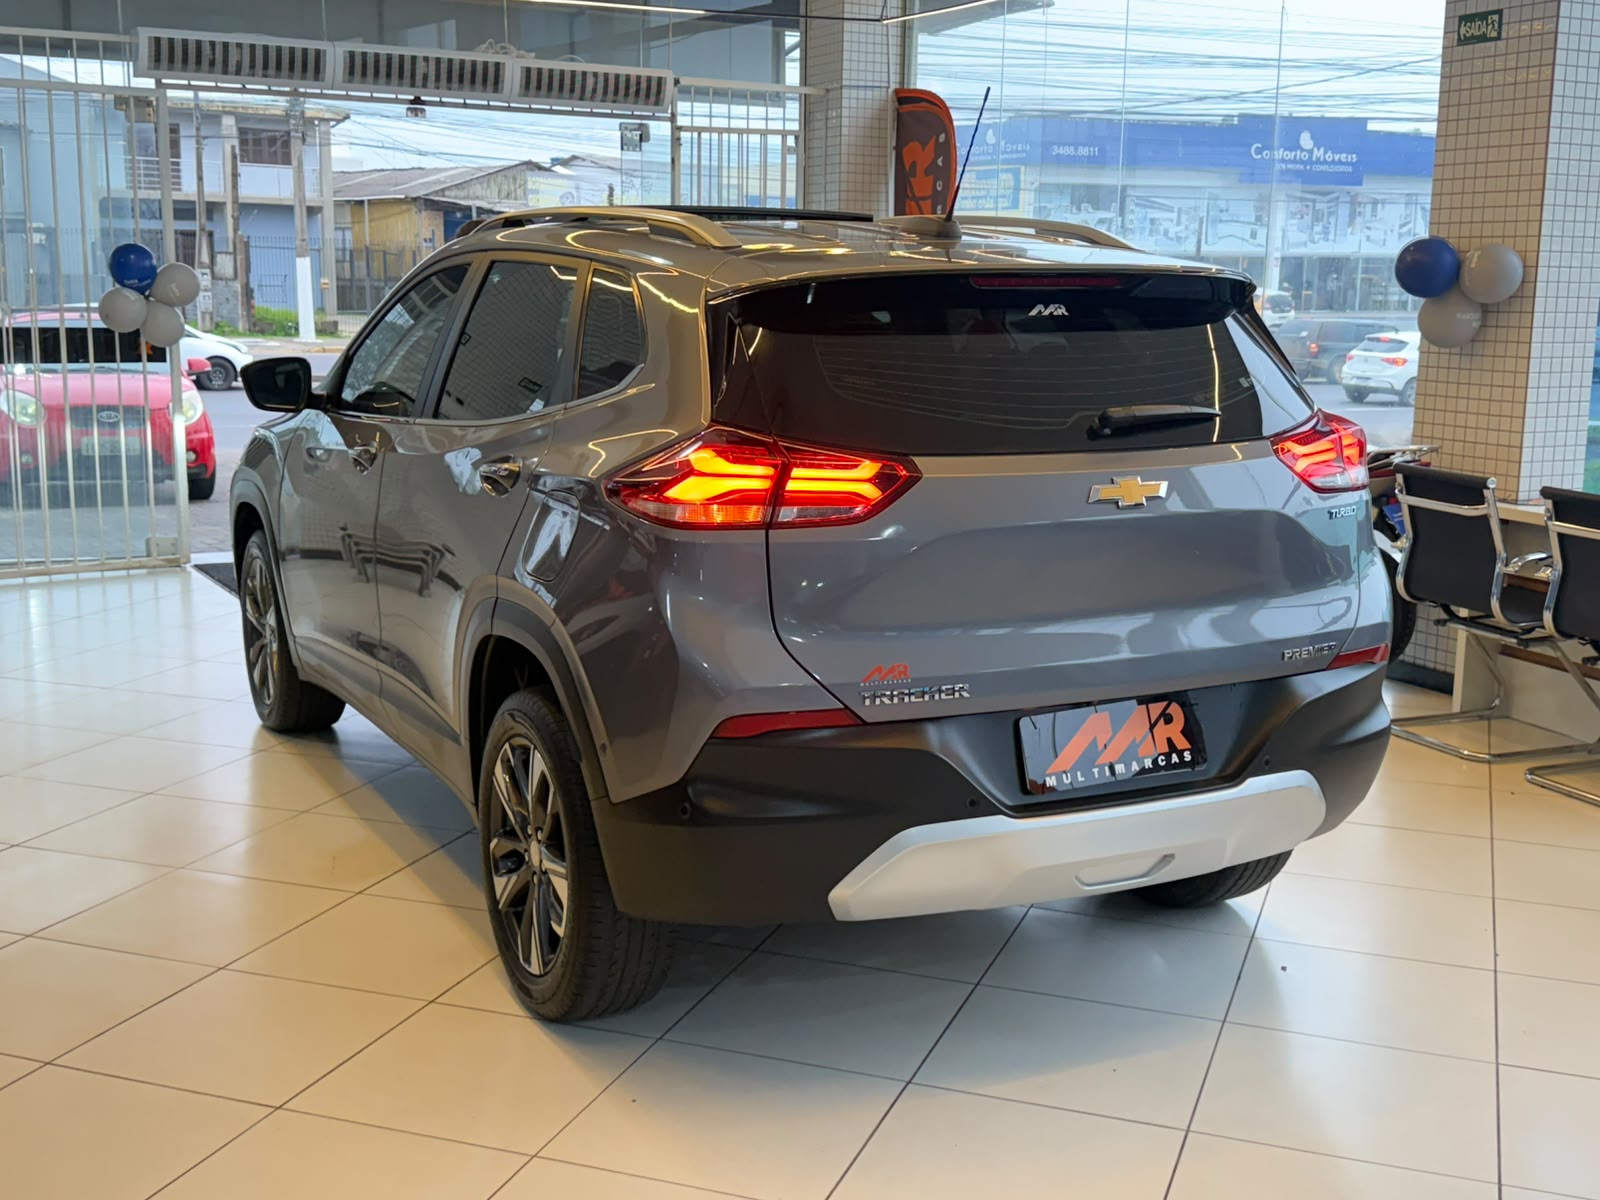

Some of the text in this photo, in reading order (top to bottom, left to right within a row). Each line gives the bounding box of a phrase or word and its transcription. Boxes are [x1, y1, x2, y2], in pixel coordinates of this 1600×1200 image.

[1464, 17, 1487, 37] SAÍDA
[1052, 145, 1099, 156] 3488.8811
[1328, 505, 1356, 520] TURBO
[1283, 642, 1337, 662] PREMIER
[861, 683, 971, 706] TRACKER
[1045, 751, 1192, 788] MULTIMARCAS
